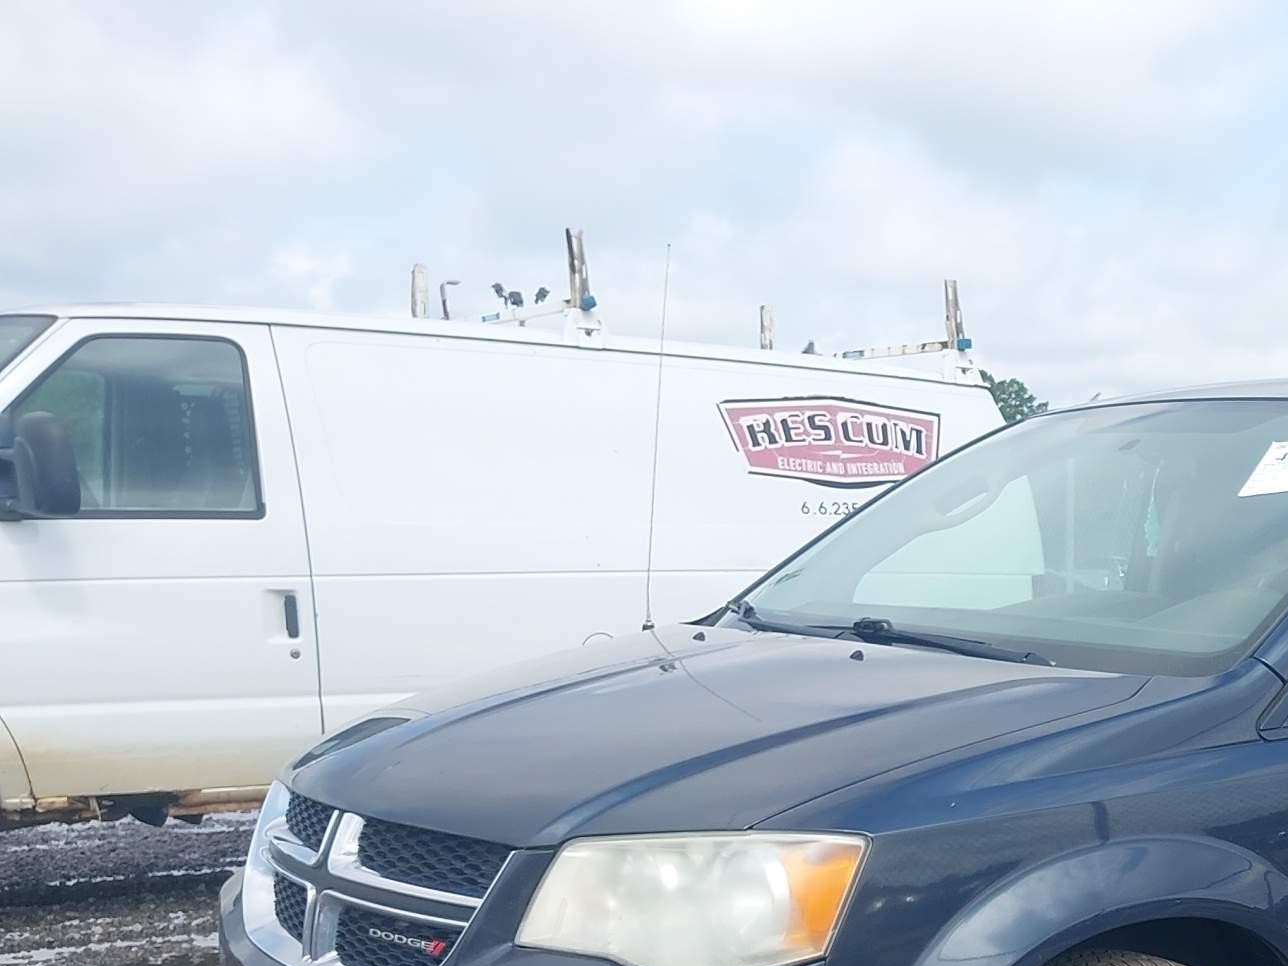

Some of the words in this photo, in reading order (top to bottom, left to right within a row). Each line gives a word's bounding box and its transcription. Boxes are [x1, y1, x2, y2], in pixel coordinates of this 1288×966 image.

[777, 456, 824, 473] ELECTRIC
[825, 461, 845, 474] AND
[846, 462, 905, 475] INTEGRATION
[368, 928, 434, 952] DODGE
